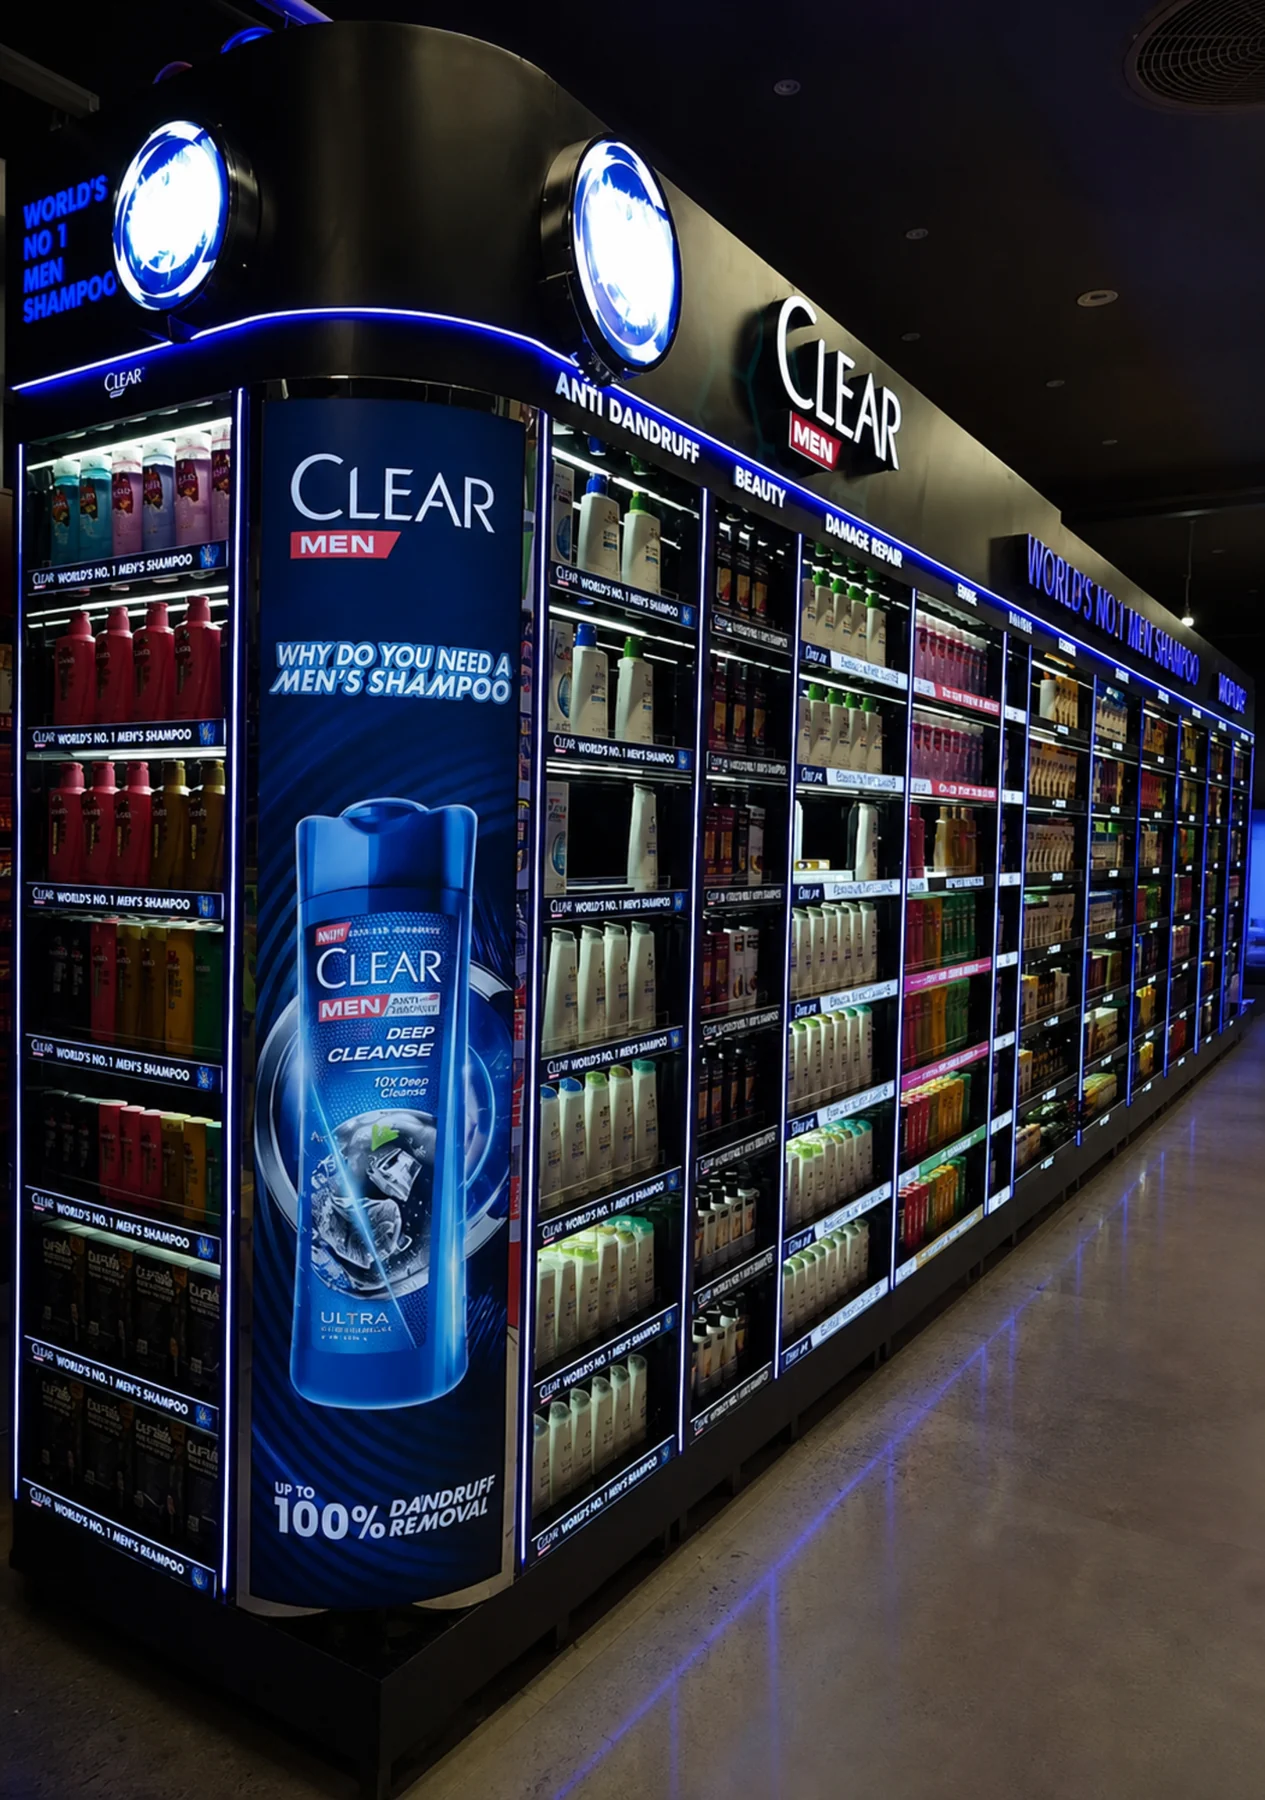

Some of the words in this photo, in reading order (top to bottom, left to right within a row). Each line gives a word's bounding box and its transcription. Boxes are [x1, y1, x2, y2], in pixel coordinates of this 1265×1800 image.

[23, 174, 109, 230] WORLD'S
[23, 230, 51, 261] NO
[57, 223, 68, 248] 1
[23, 257, 64, 294] MEN
[23, 270, 118, 324] SHAMPOO
[104, 368, 142, 391] CLEAR
[777, 295, 902, 470] CLEAR
[555, 372, 603, 417] ANTI
[609, 397, 700, 464] DANDRUFF
[793, 419, 834, 464] MEN
[290, 453, 495, 533] CLEAR
[734, 466, 786, 509] BEAUTY
[300, 535, 374, 554] MEN
[825, 513, 870, 553] DAMAGE
[871, 538, 904, 568] REPAIR
[1028, 533, 1093, 622] WORLD'S
[1127, 608, 1152, 659] MEN
[1155, 625, 1200, 686] SHAMPOO
[277, 643, 332, 666] WHY
[337, 644, 374, 666] DO
[381, 644, 432, 669] YOU
[438, 648, 492, 673] NEED
[496, 656, 510, 677] A
[270, 670, 364, 693] MEN'S
[369, 671, 510, 702] SHAMPOO
[316, 948, 442, 989] CLEAR
[321, 998, 380, 1019] MEN
[328, 1043, 434, 1063] CLEANSE
[386, 1026, 435, 1040] DEEP
[374, 1077, 396, 1088] 10X
[320, 1312, 389, 1324] ULTRA
[274, 1481, 292, 1496] UP
[296, 1485, 315, 1498] TO
[389, 1474, 496, 1518] DANDRUFF
[274, 1496, 386, 1540] 100%
[389, 1496, 488, 1537] REMOVAL
